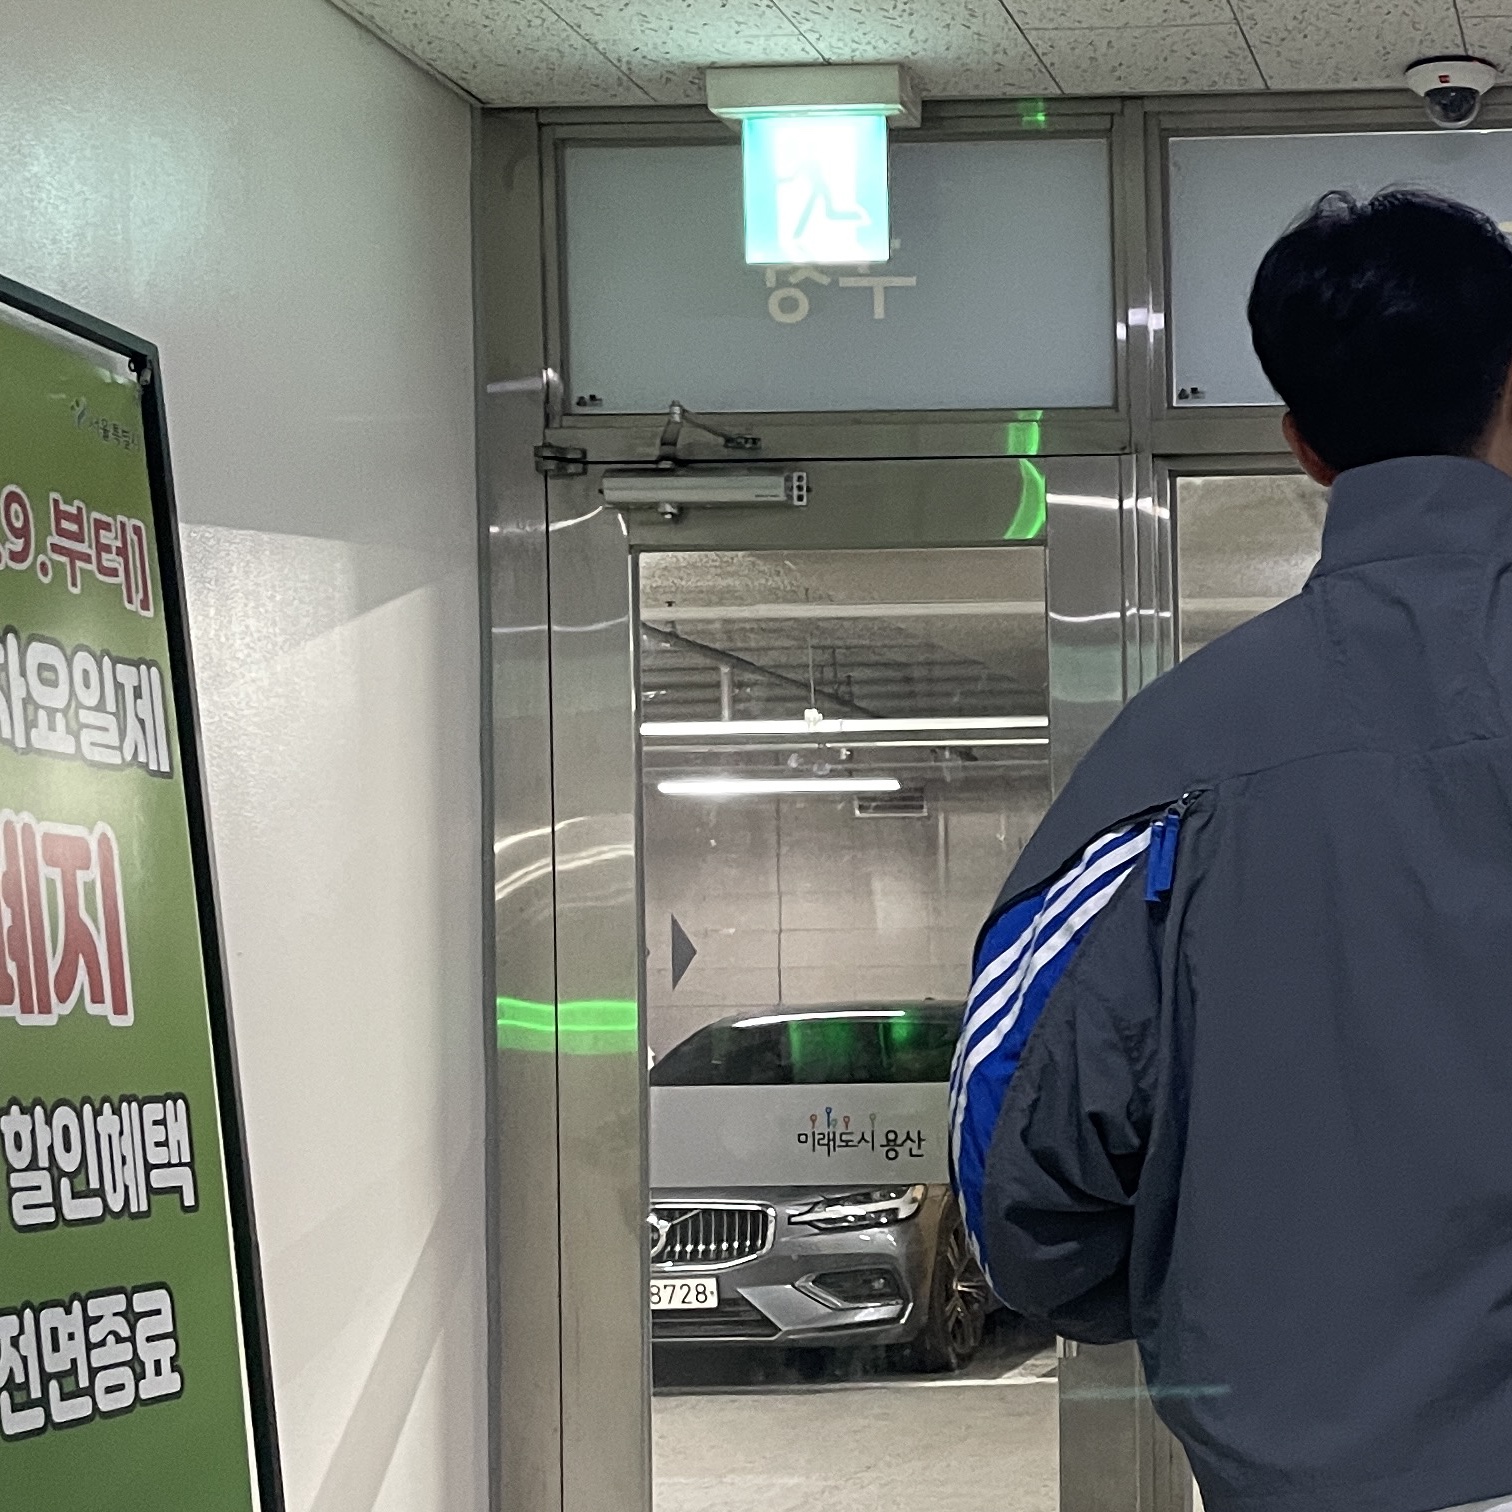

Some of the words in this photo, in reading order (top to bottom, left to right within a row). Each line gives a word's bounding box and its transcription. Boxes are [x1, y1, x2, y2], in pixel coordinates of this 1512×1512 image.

[0, 1098, 196, 1226] 할인혜택
[797, 1128, 876, 1158] 미래도시
[879, 1128, 926, 1161] 용산
[650, 1283, 708, 1305] 8728
[0, 1288, 182, 1435] 전면종료
